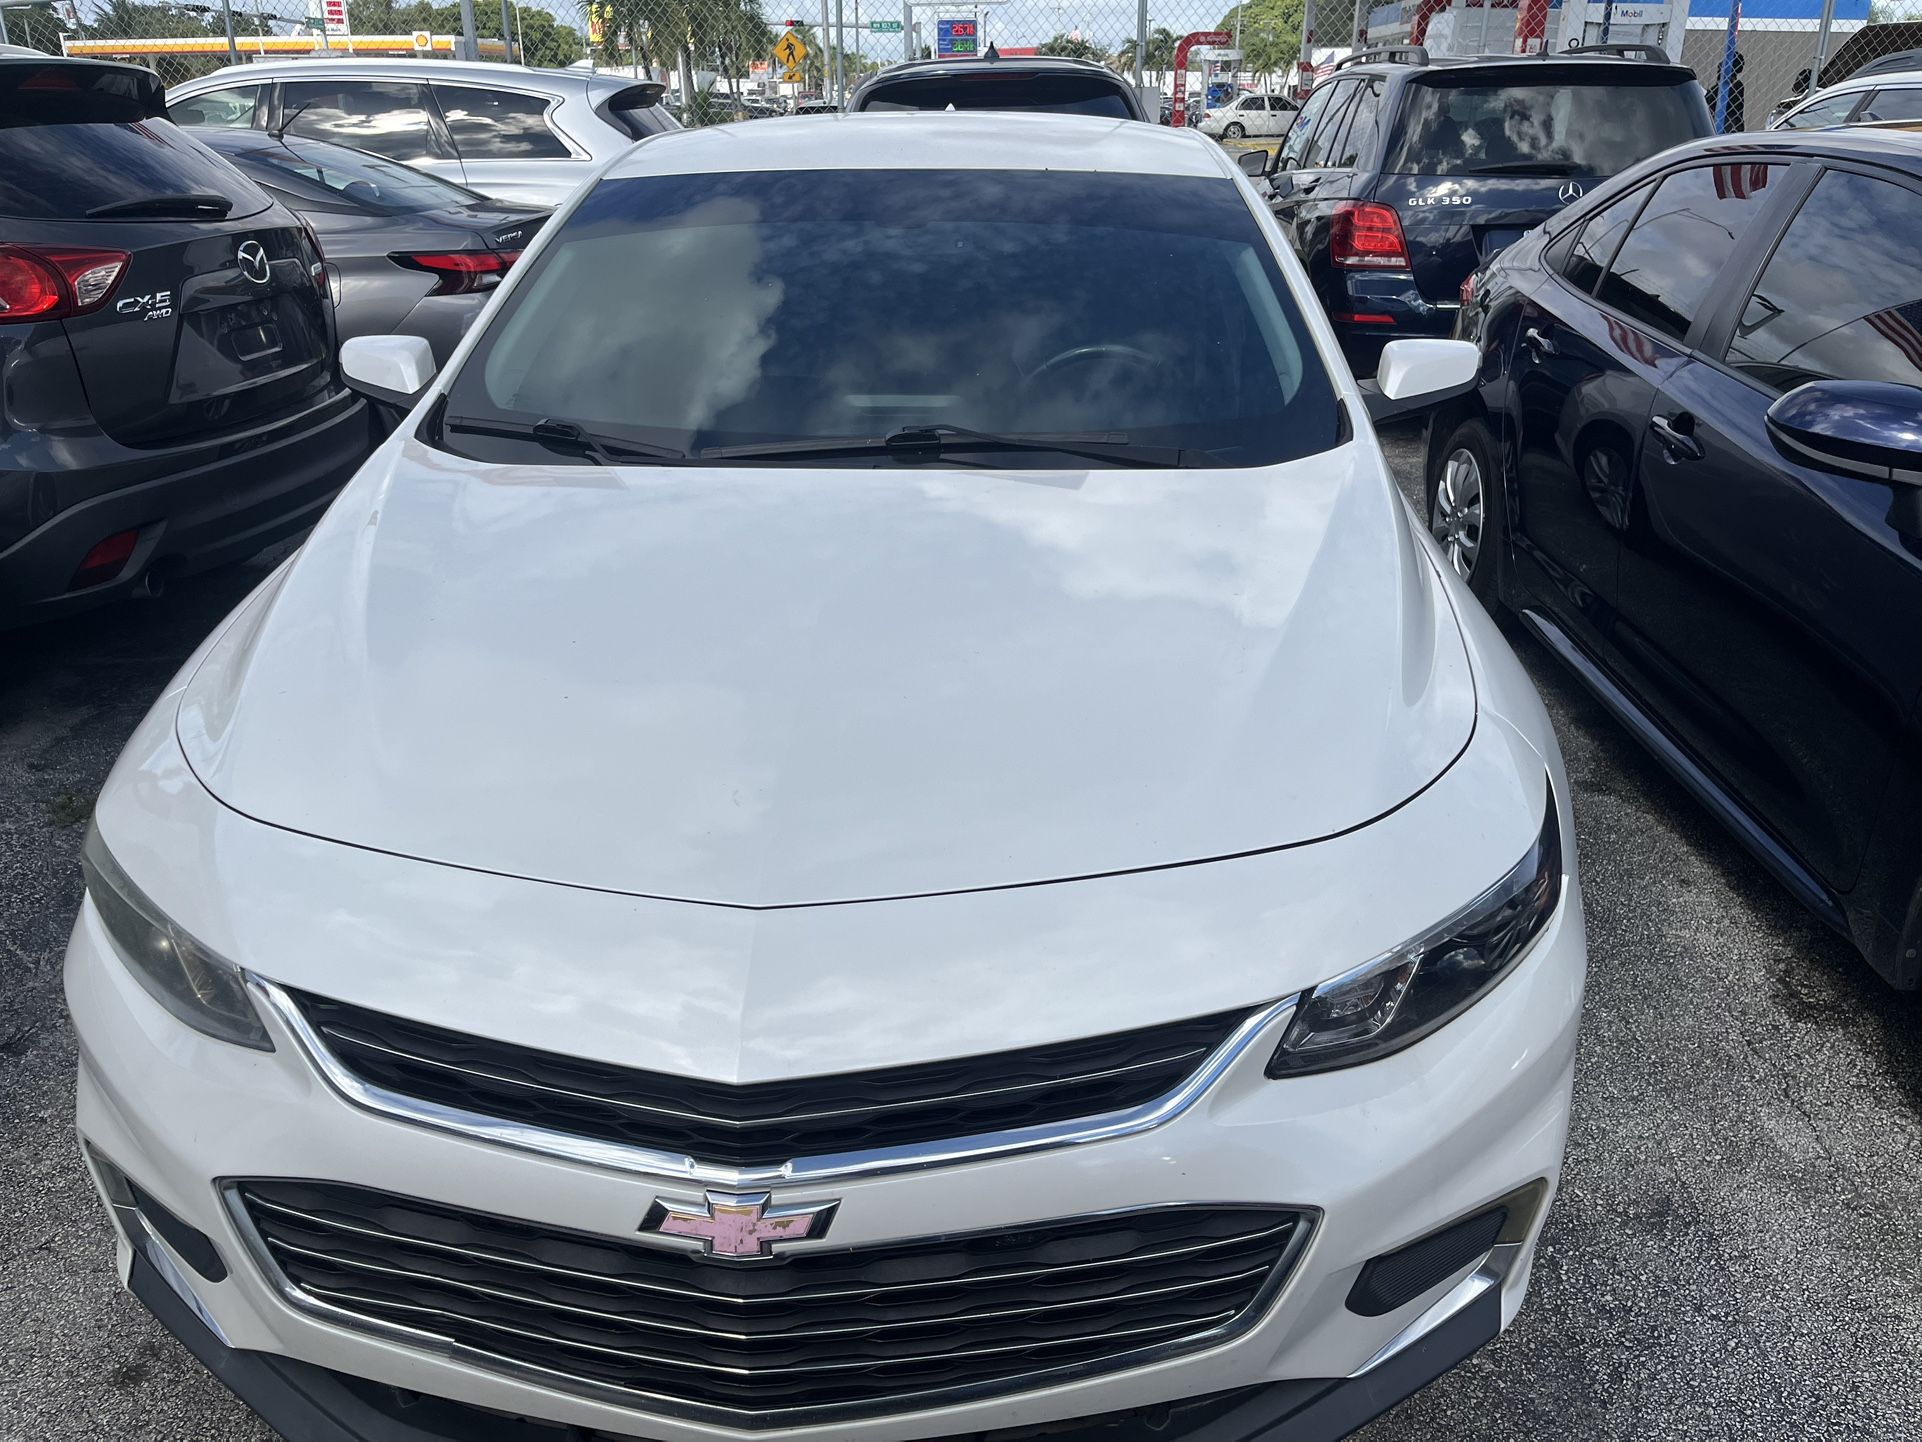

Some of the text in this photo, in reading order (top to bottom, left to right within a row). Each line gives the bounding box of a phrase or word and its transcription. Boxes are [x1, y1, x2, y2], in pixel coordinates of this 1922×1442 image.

[1620, 9, 1644, 18] Mobil
[1408, 196, 1472, 206] GLK 350
[494, 230, 523, 244] VERSA
[116, 290, 171, 314] CX-5
[143, 307, 172, 322] AWD
